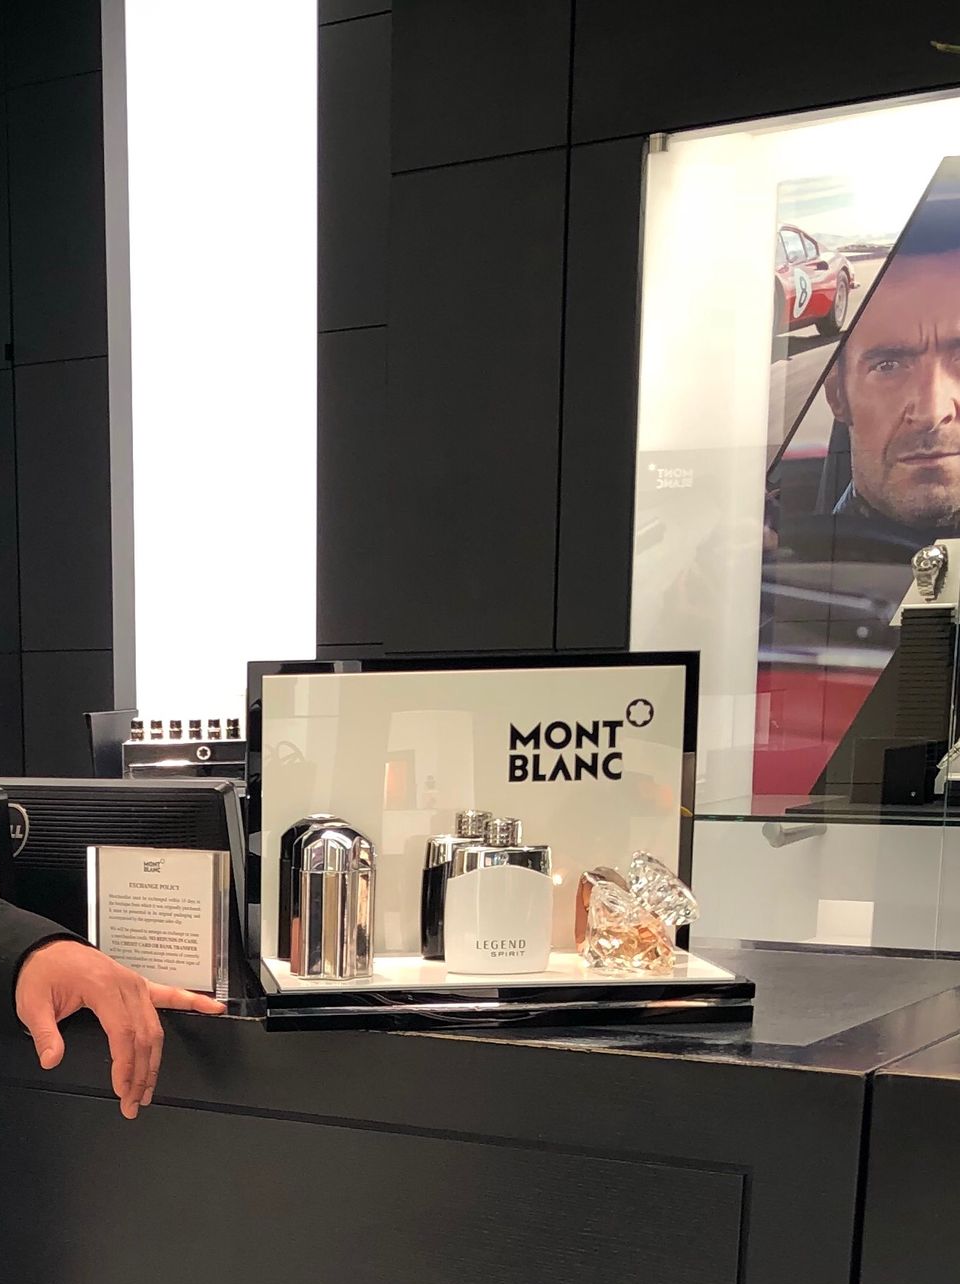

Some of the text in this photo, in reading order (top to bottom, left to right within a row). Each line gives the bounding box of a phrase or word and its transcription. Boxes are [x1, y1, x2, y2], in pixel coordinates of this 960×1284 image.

[799, 276, 808, 308] 8
[509, 720, 623, 750] MONT
[508, 752, 622, 782] BLANC
[129, 882, 158, 890] EXCHANGE
[476, 939, 526, 950] LEGEND
